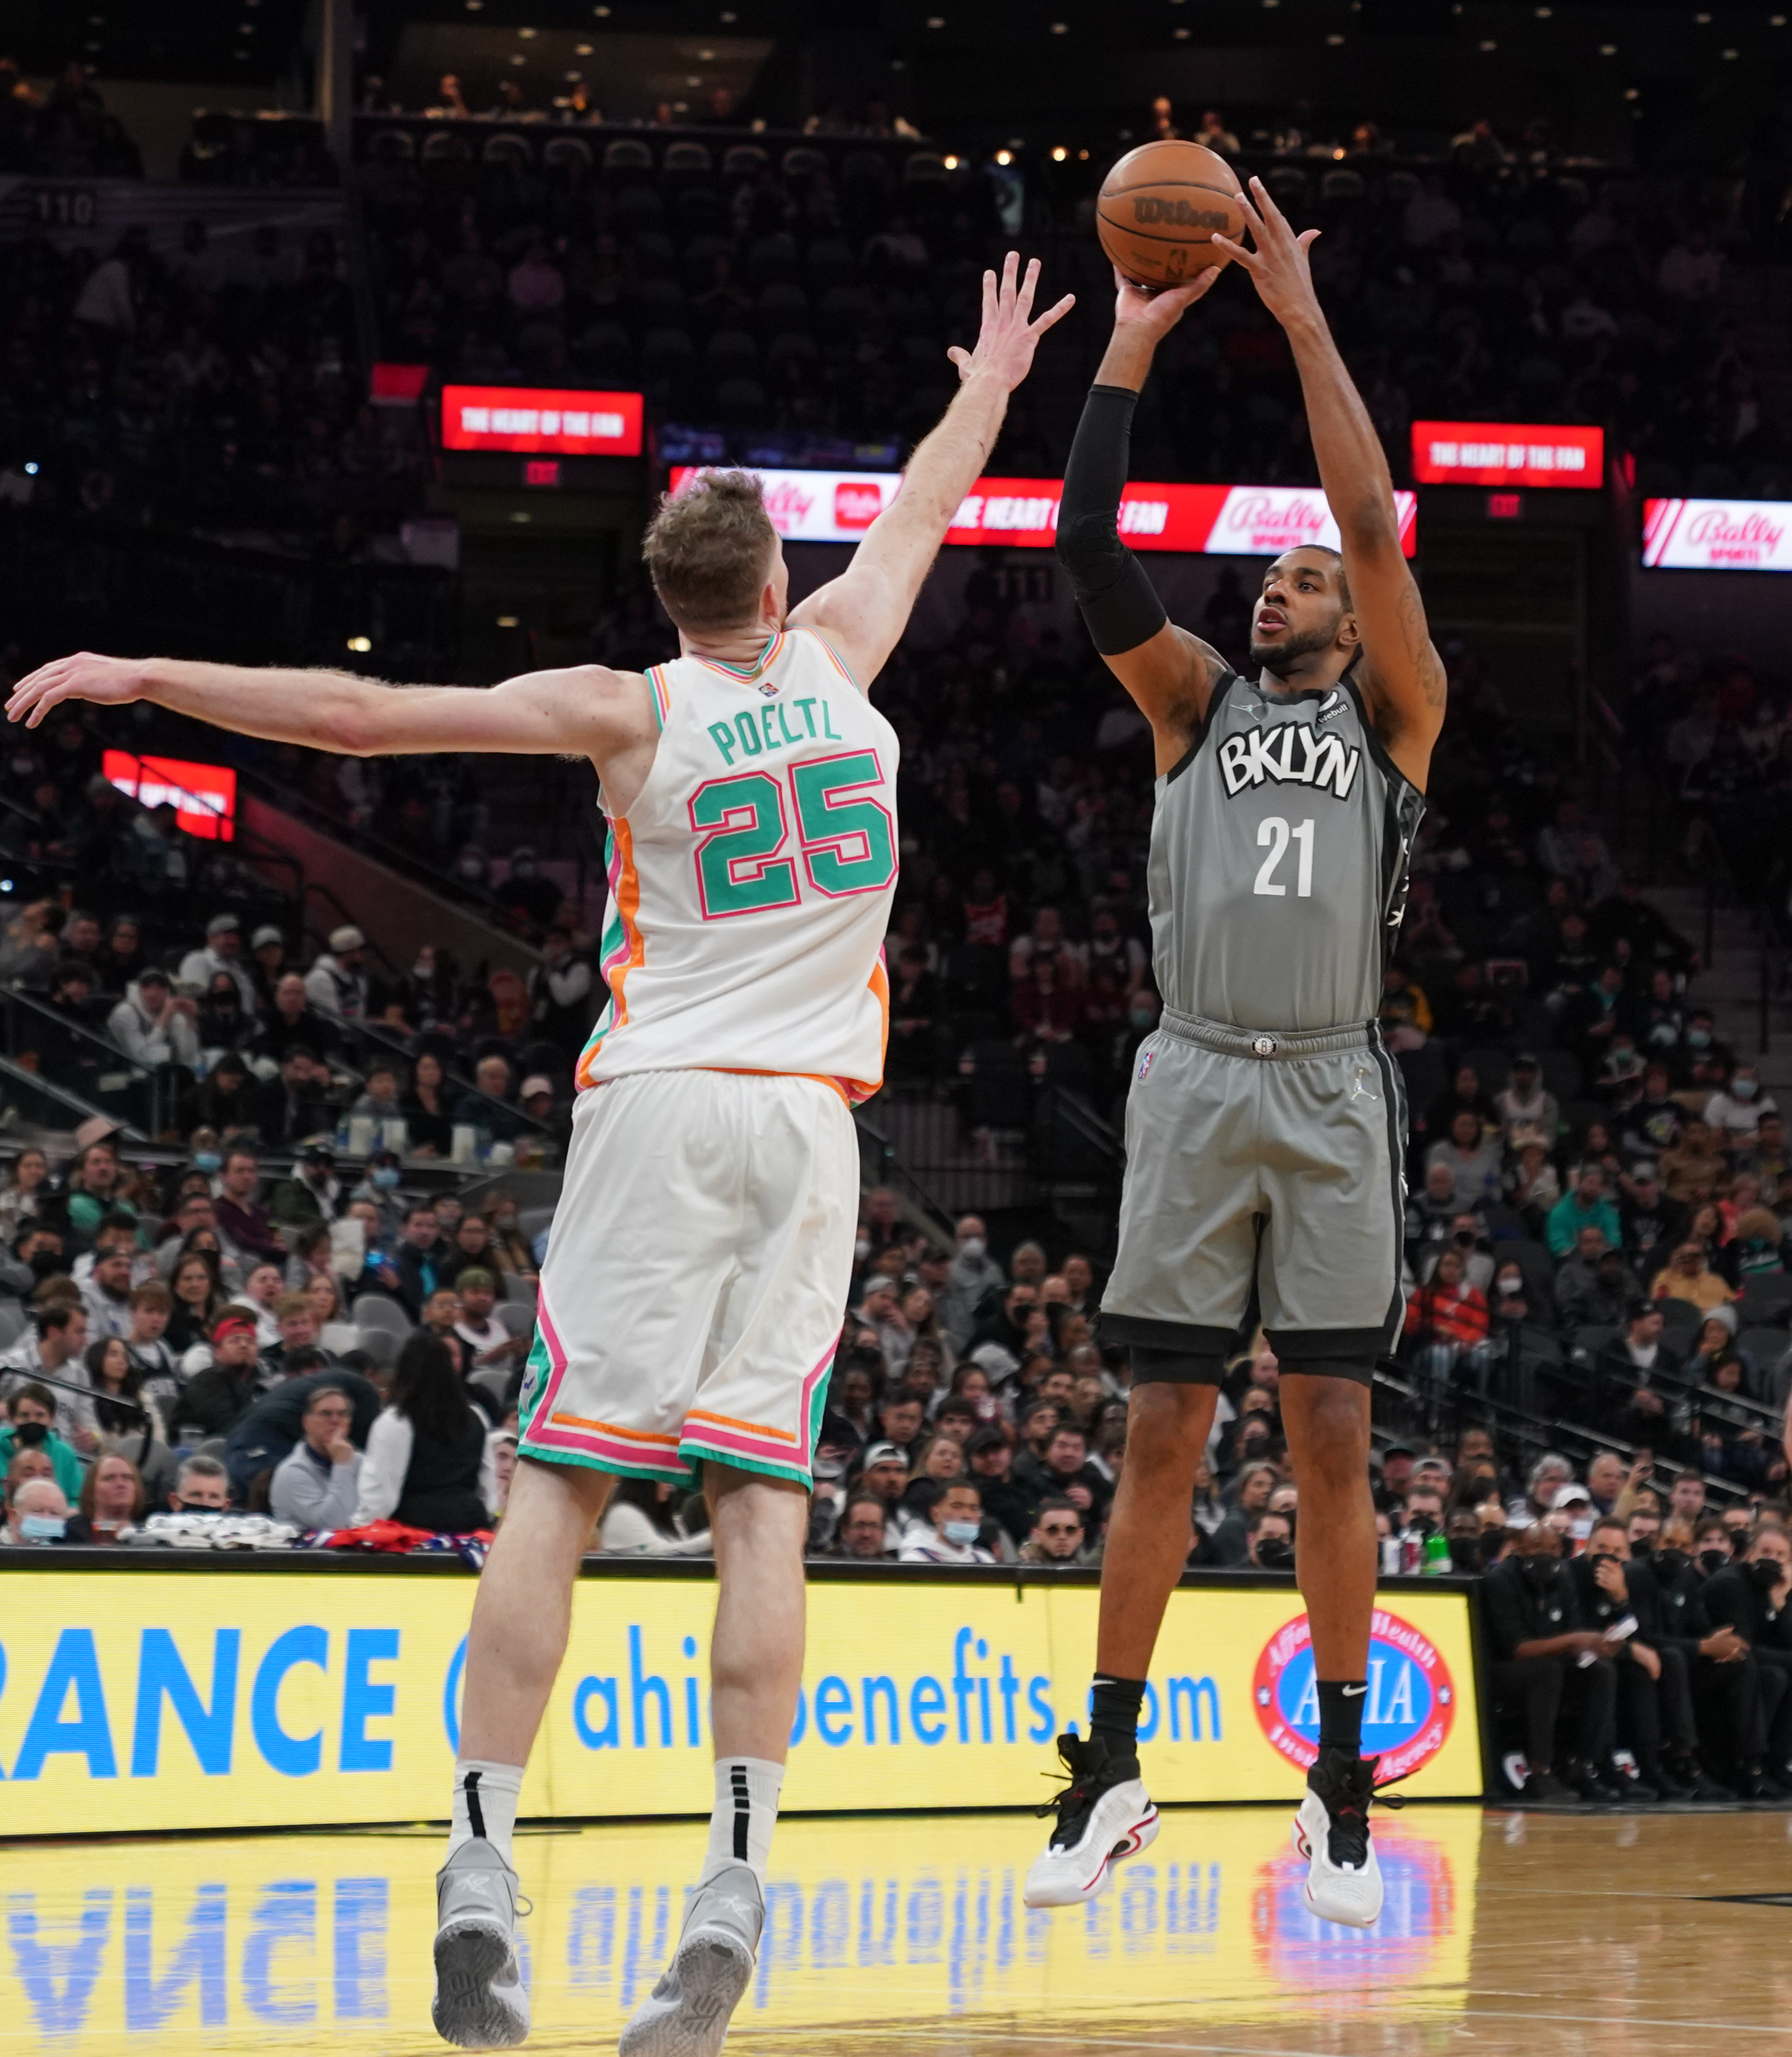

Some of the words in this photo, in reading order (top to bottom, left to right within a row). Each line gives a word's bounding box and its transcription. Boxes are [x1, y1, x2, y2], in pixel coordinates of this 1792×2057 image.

[38, 192, 92, 224] 110
[1134, 196, 1229, 231] Wilson
[1429, 441, 1457, 467] THE
[983, 496, 1052, 531] HEART
[1119, 501, 1168, 535] FAN
[1228, 496, 1328, 543] Bally
[1687, 509, 1785, 556] Bally
[708, 697, 842, 766] POELTL
[1318, 703, 1349, 723] webull
[1218, 722, 1359, 800] BKLYN
[687, 748, 899, 922] 25
[1254, 816, 1315, 897] 21
[1370, 1612, 1437, 1669] Health
[0, 1625, 401, 1781] ANCE
[1291, 1659, 1417, 1725] AIA
